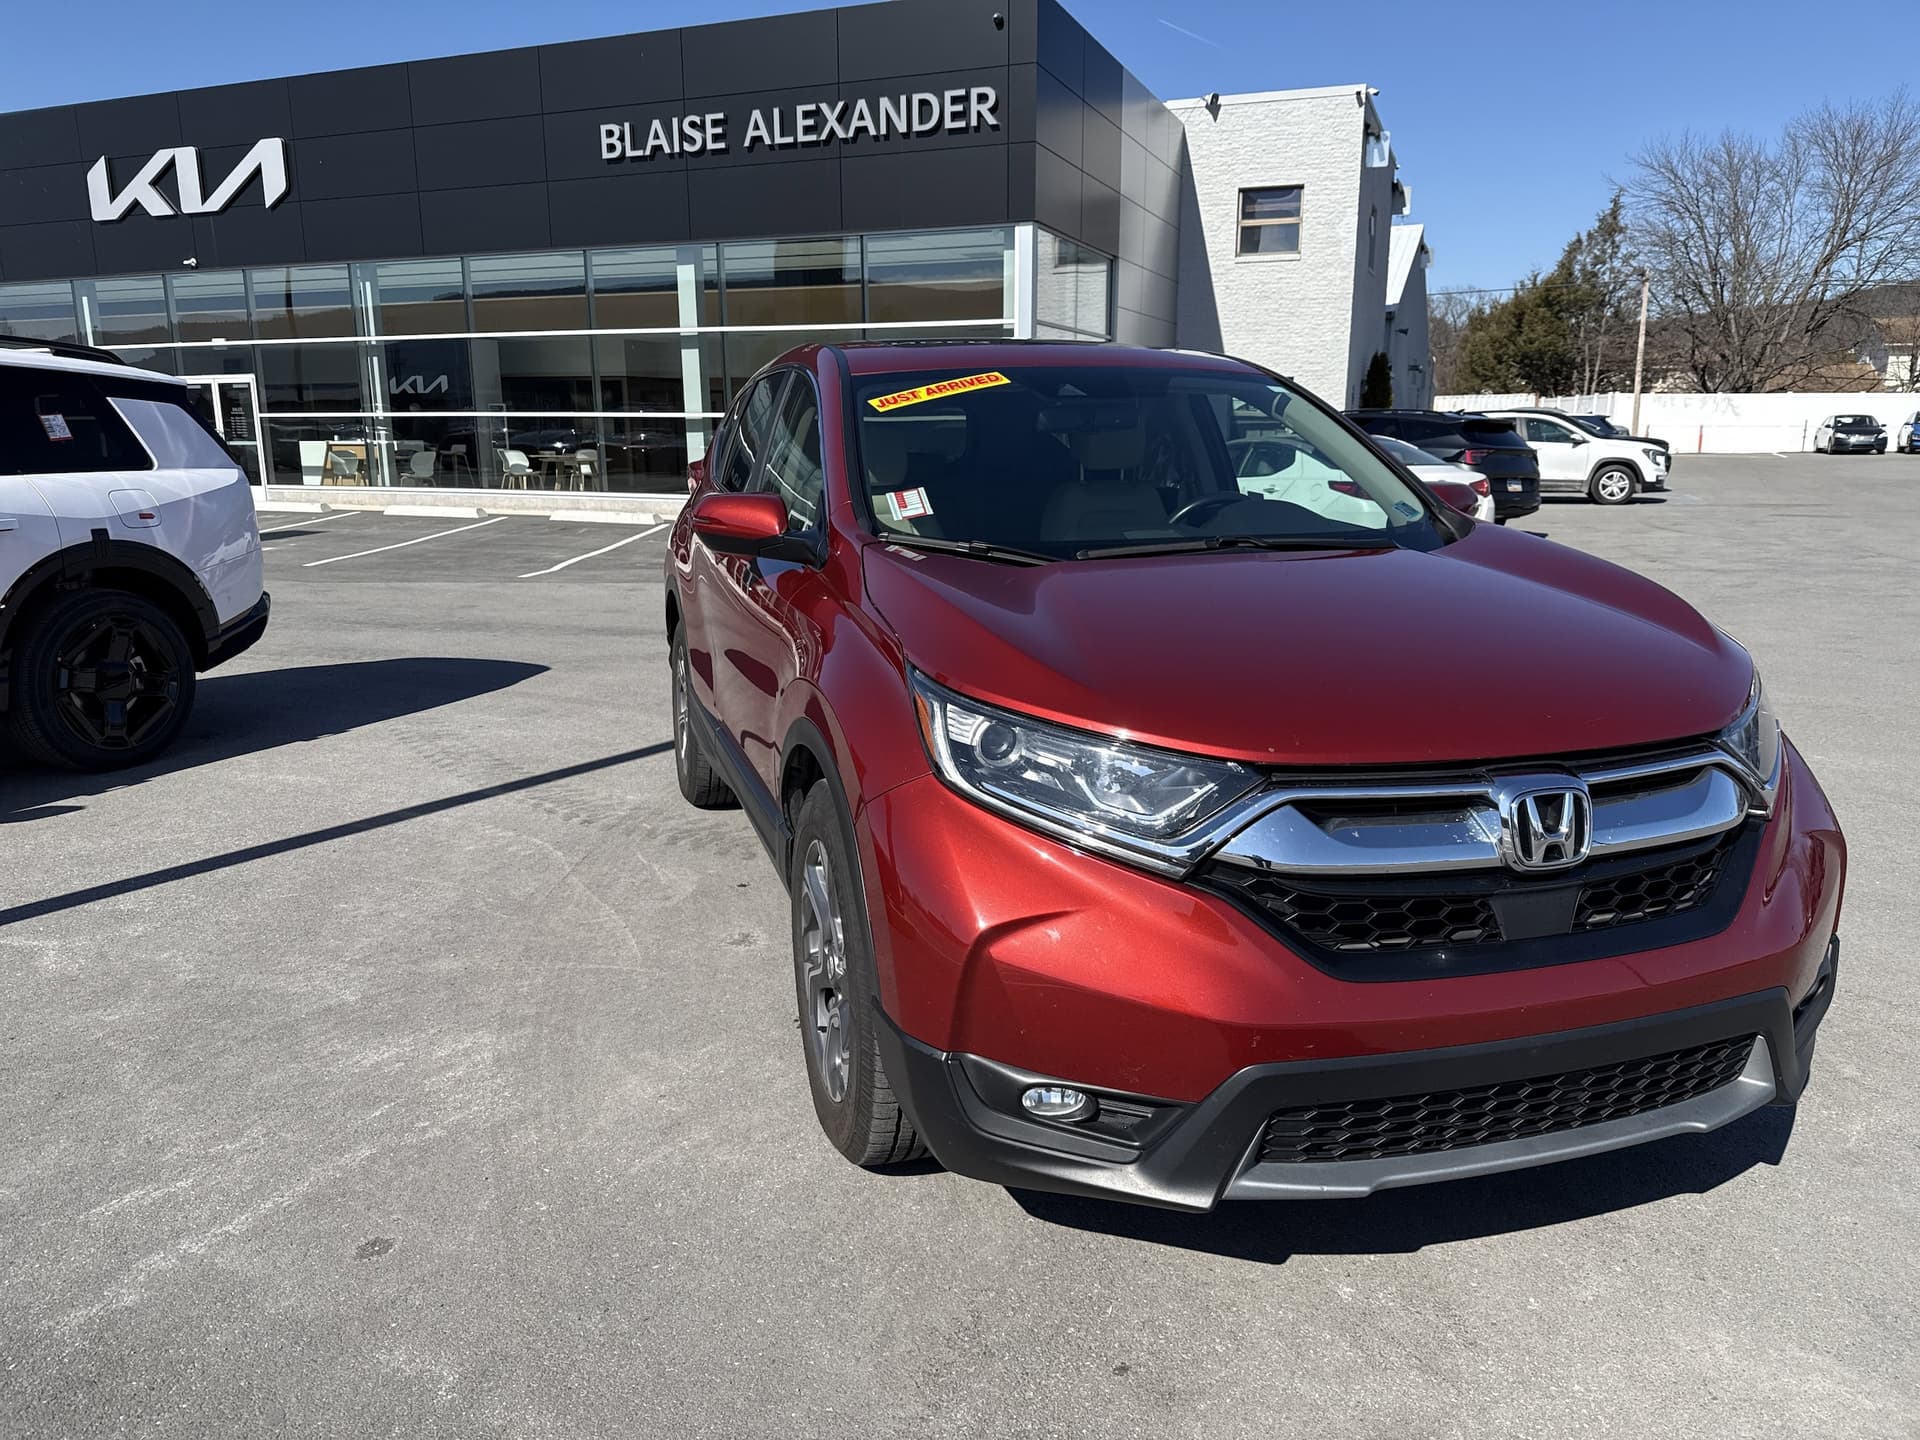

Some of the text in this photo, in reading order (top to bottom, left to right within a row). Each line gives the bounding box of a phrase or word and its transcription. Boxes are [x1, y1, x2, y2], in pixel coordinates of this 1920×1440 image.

[599, 86, 1001, 160] BLAISE ALEXANDER
[86, 137, 288, 222] KIA
[389, 375, 449, 394] KIA
[876, 374, 1000, 408] JUST ARRIVED
